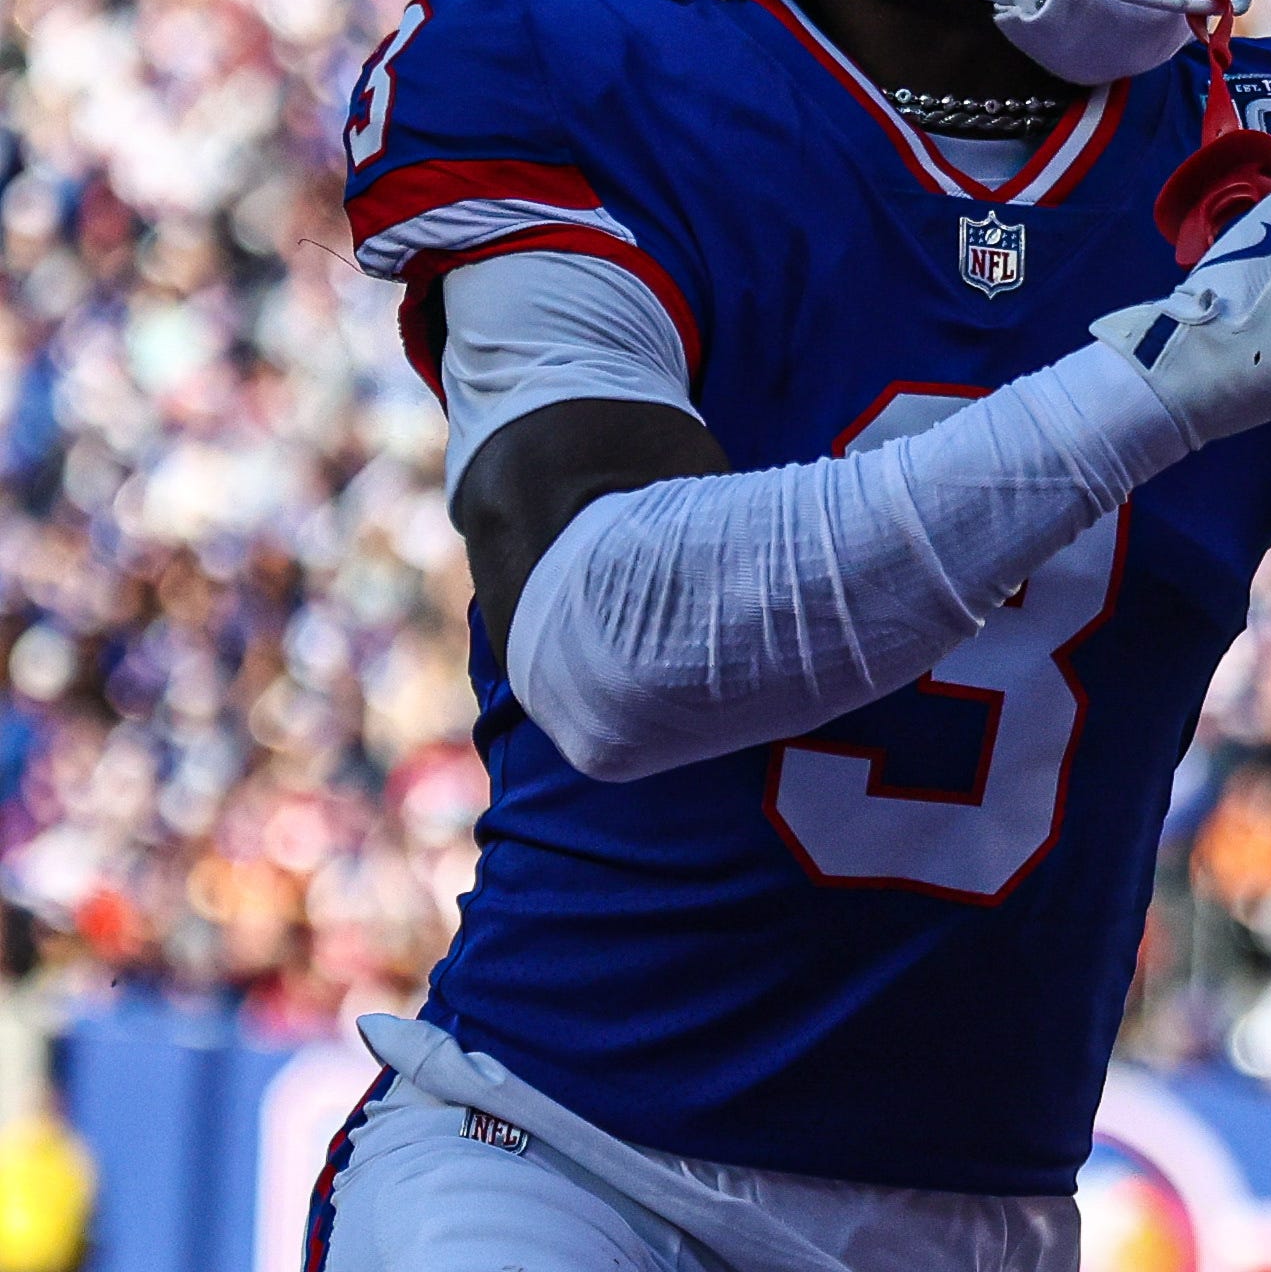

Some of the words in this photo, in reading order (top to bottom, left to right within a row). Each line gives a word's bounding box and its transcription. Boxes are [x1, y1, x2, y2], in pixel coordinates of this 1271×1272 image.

[969, 247, 1015, 283] NFL
[762, 380, 1131, 908] 3
[470, 1114, 519, 1147] NFL
